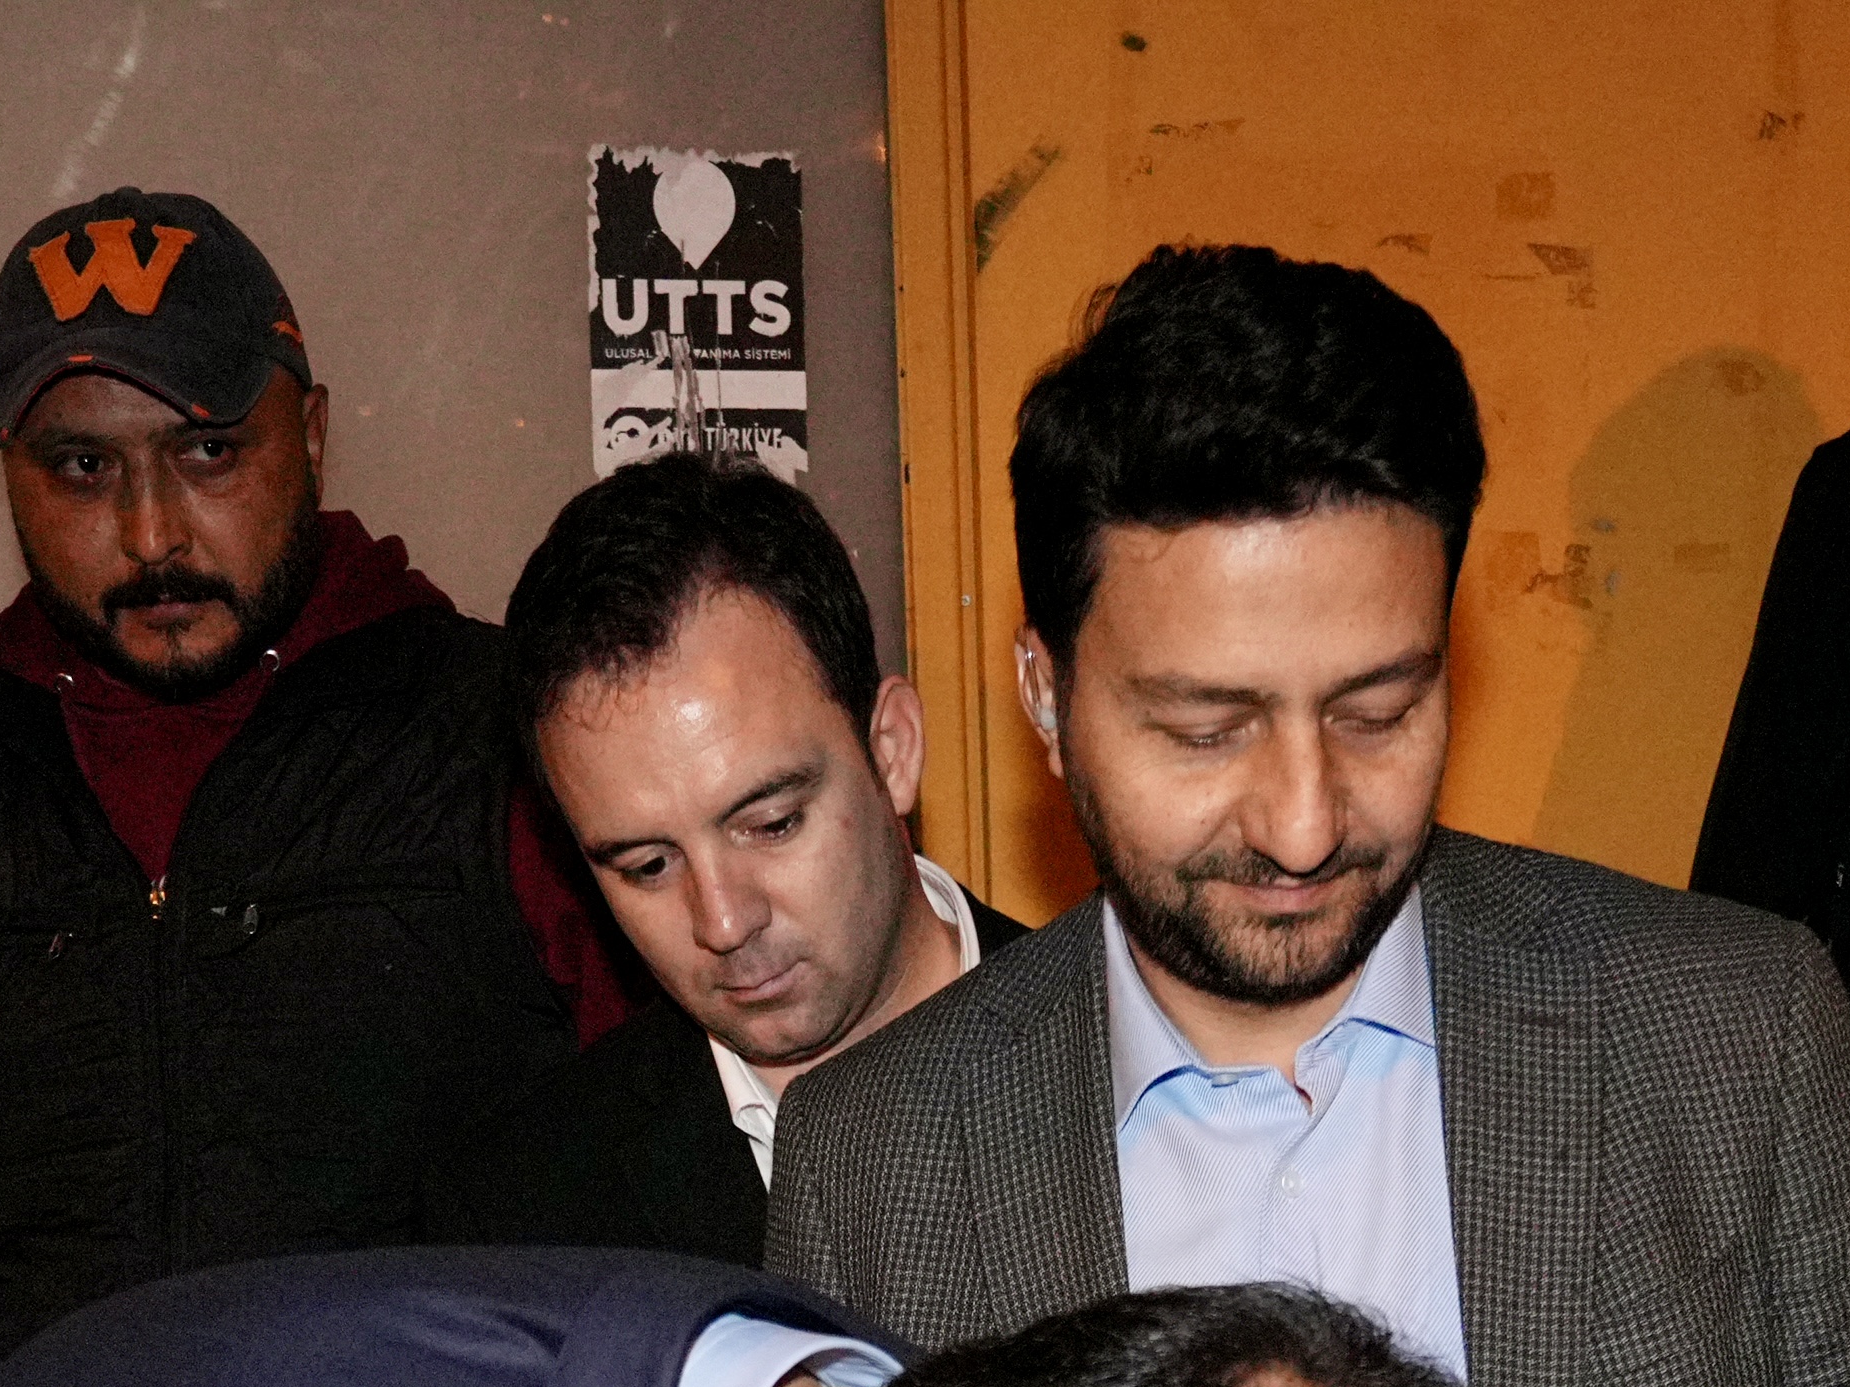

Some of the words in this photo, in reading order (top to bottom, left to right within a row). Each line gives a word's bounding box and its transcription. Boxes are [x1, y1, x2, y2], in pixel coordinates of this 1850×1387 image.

[28, 217, 198, 322] W
[601, 278, 792, 338] UTTS
[605, 348, 652, 359] ULUSAL
[693, 348, 741, 359] TANIMA
[744, 347, 791, 360] SİSTEMİ
